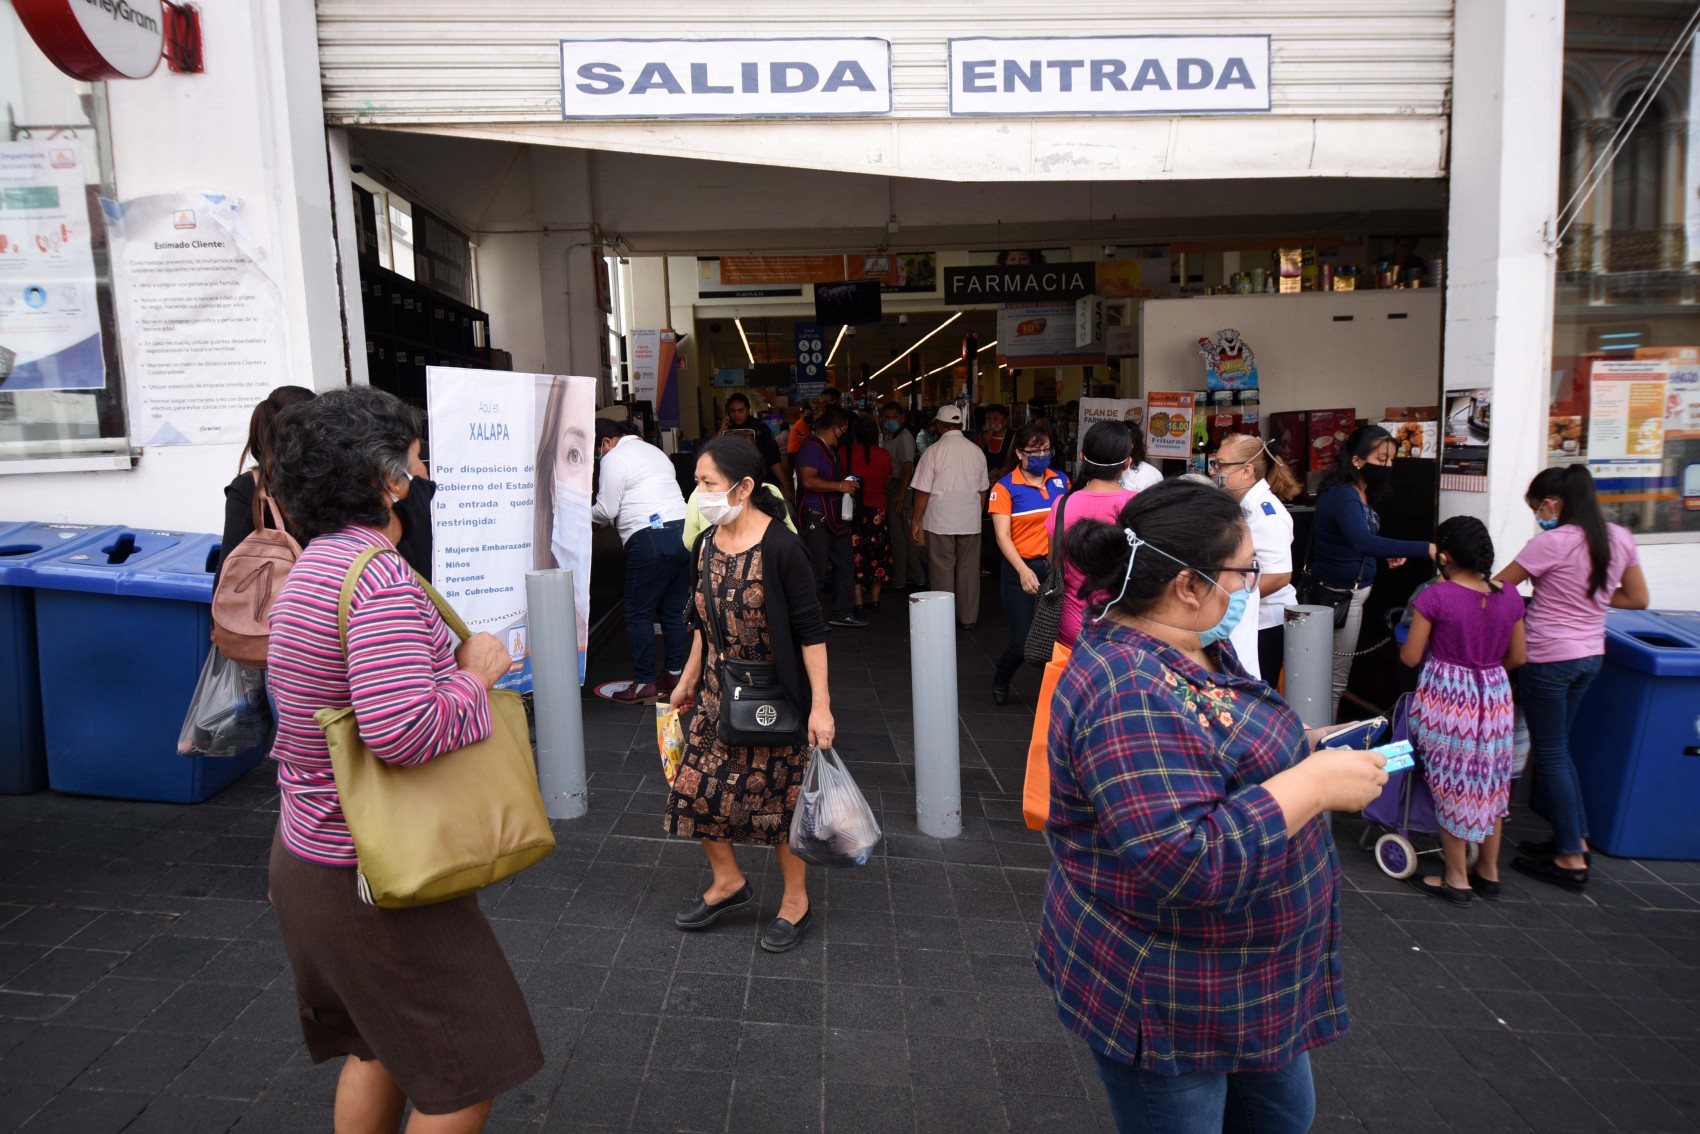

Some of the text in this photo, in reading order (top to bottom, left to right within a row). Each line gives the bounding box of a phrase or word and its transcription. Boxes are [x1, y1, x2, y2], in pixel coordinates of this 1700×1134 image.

[576, 60, 877, 95] SALIDA
[962, 58, 1256, 93] ENTRADA
[154, 242, 190, 250] Estimado
[953, 273, 1085, 293] FARMACIA
[1168, 422, 1189, 430] 16.00
[470, 422, 510, 440] XALAPA
[460, 465, 518, 474] disposición
[436, 483, 484, 491] Gobierno
[510, 499, 533, 507] queda
[437, 518, 496, 527] restringida:
[445, 542, 531, 554] Mujeres Embarazadas
[446, 574, 485, 583] Personas
[465, 586, 514, 596] Cubrebocas
